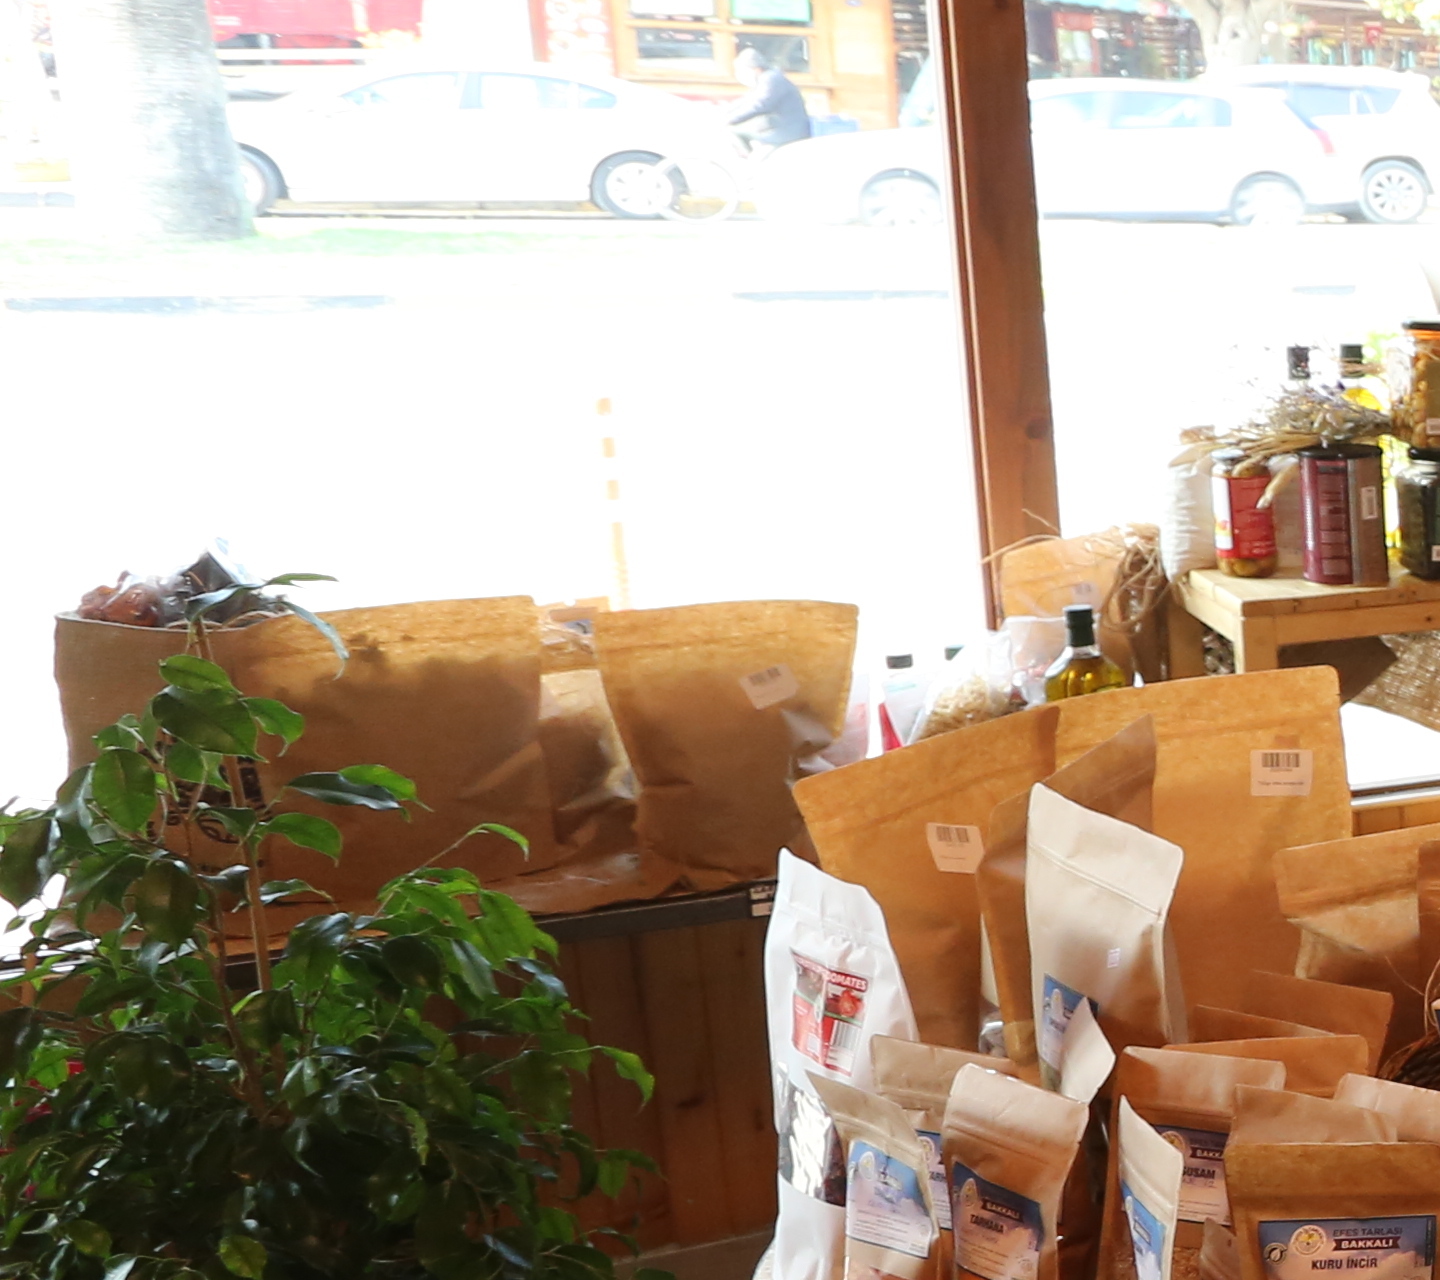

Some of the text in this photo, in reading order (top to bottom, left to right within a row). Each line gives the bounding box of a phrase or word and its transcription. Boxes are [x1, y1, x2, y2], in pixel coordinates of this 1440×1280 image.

[1332, 1228, 1358, 1237] EFES
[1341, 1238, 1394, 1249] BAKKALI
[1311, 1256, 1378, 1270] KURU İNCİR
